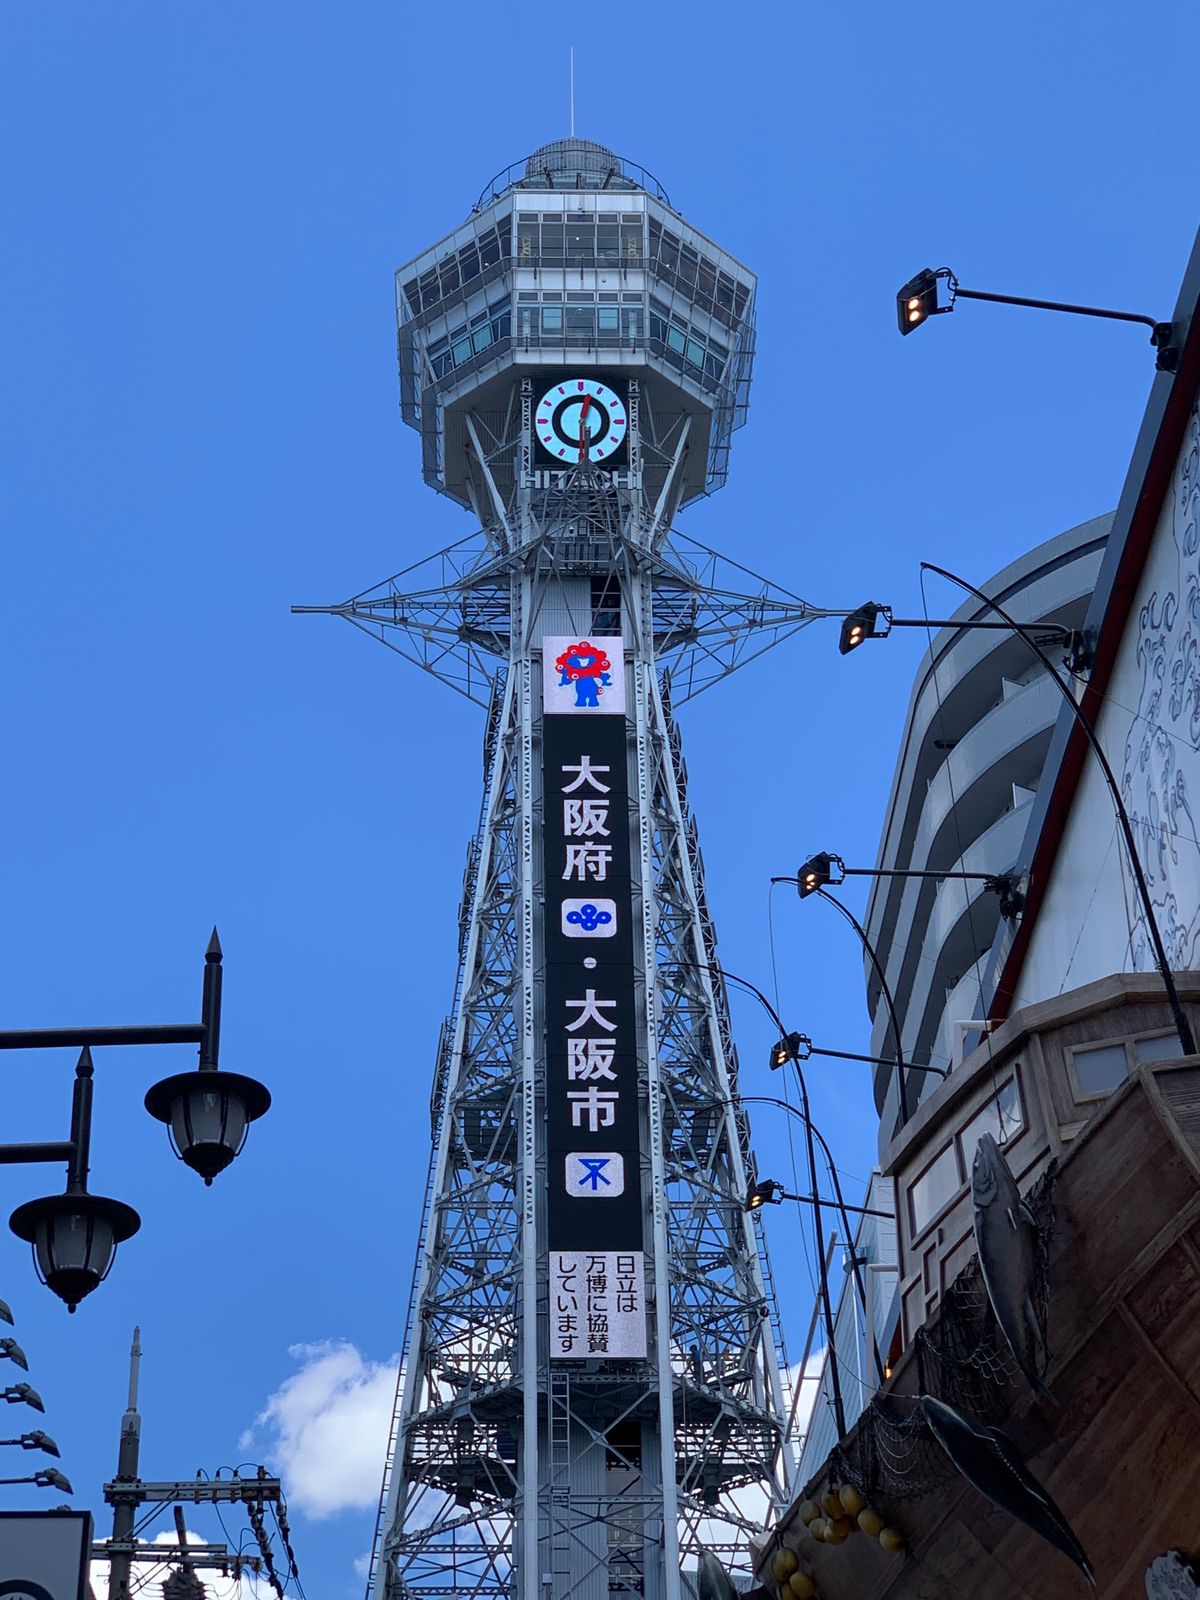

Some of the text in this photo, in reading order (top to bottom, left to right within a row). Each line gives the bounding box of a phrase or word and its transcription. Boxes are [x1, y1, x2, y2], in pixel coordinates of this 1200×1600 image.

[561, 755, 612, 881] 大阪府
[564, 989, 619, 1132] 大阪市
[557, 1256, 579, 1353] しています
[586, 1256, 608, 1353] 万博に協賛
[616, 1256, 638, 1312] 日立は
